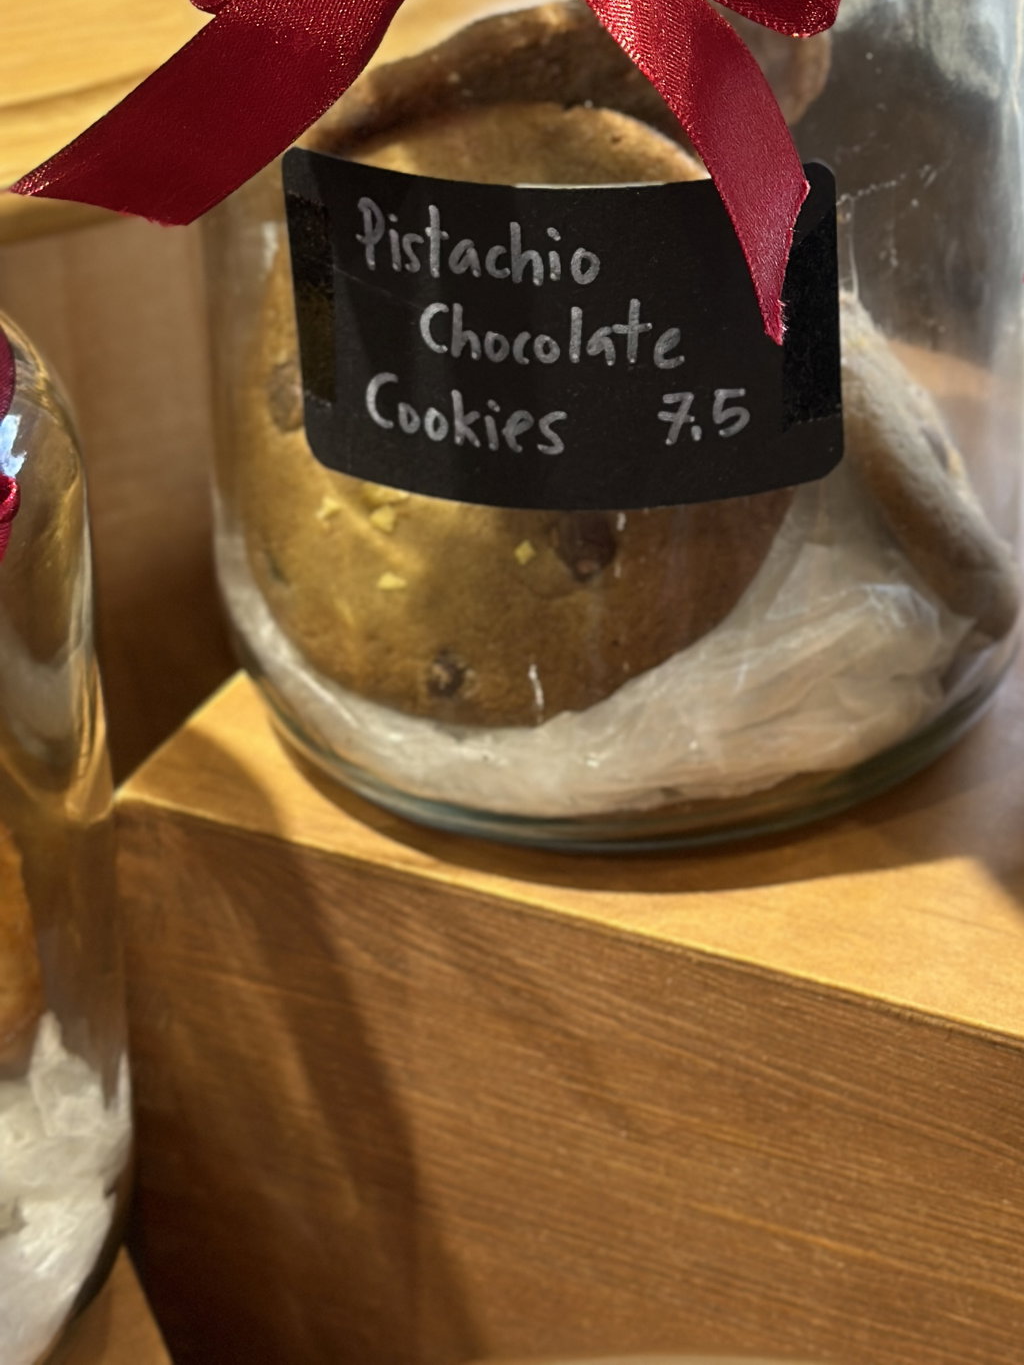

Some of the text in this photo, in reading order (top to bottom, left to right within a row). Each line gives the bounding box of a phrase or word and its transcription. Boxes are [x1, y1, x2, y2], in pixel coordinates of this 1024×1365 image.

[356, 196, 601, 286] Pistachio
[419, 298, 685, 370] Chocolate
[365, 372, 751, 455] Cookies 7.5
